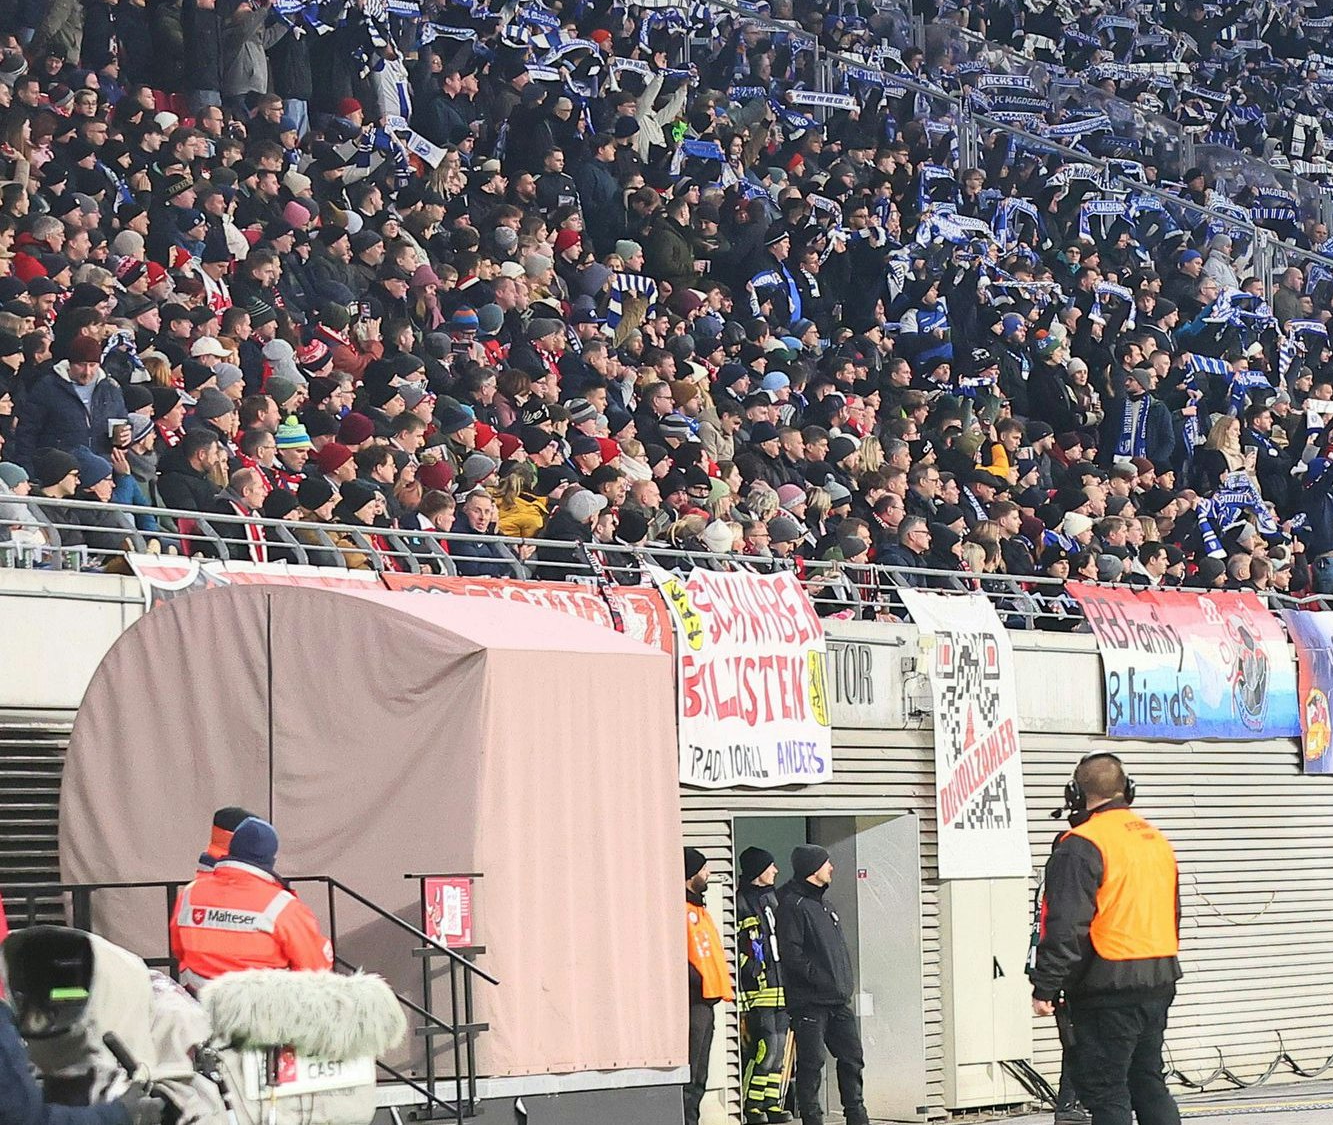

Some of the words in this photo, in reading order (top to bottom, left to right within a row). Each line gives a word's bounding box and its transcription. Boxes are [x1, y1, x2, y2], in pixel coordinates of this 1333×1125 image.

[1005, 96, 1051, 109] MAGDEBURG
[1083, 595, 1130, 651] RB
[776, 740, 825, 775] ANDERS
[208, 909, 255, 926] Malteser
[307, 1059, 343, 1080] CAST
